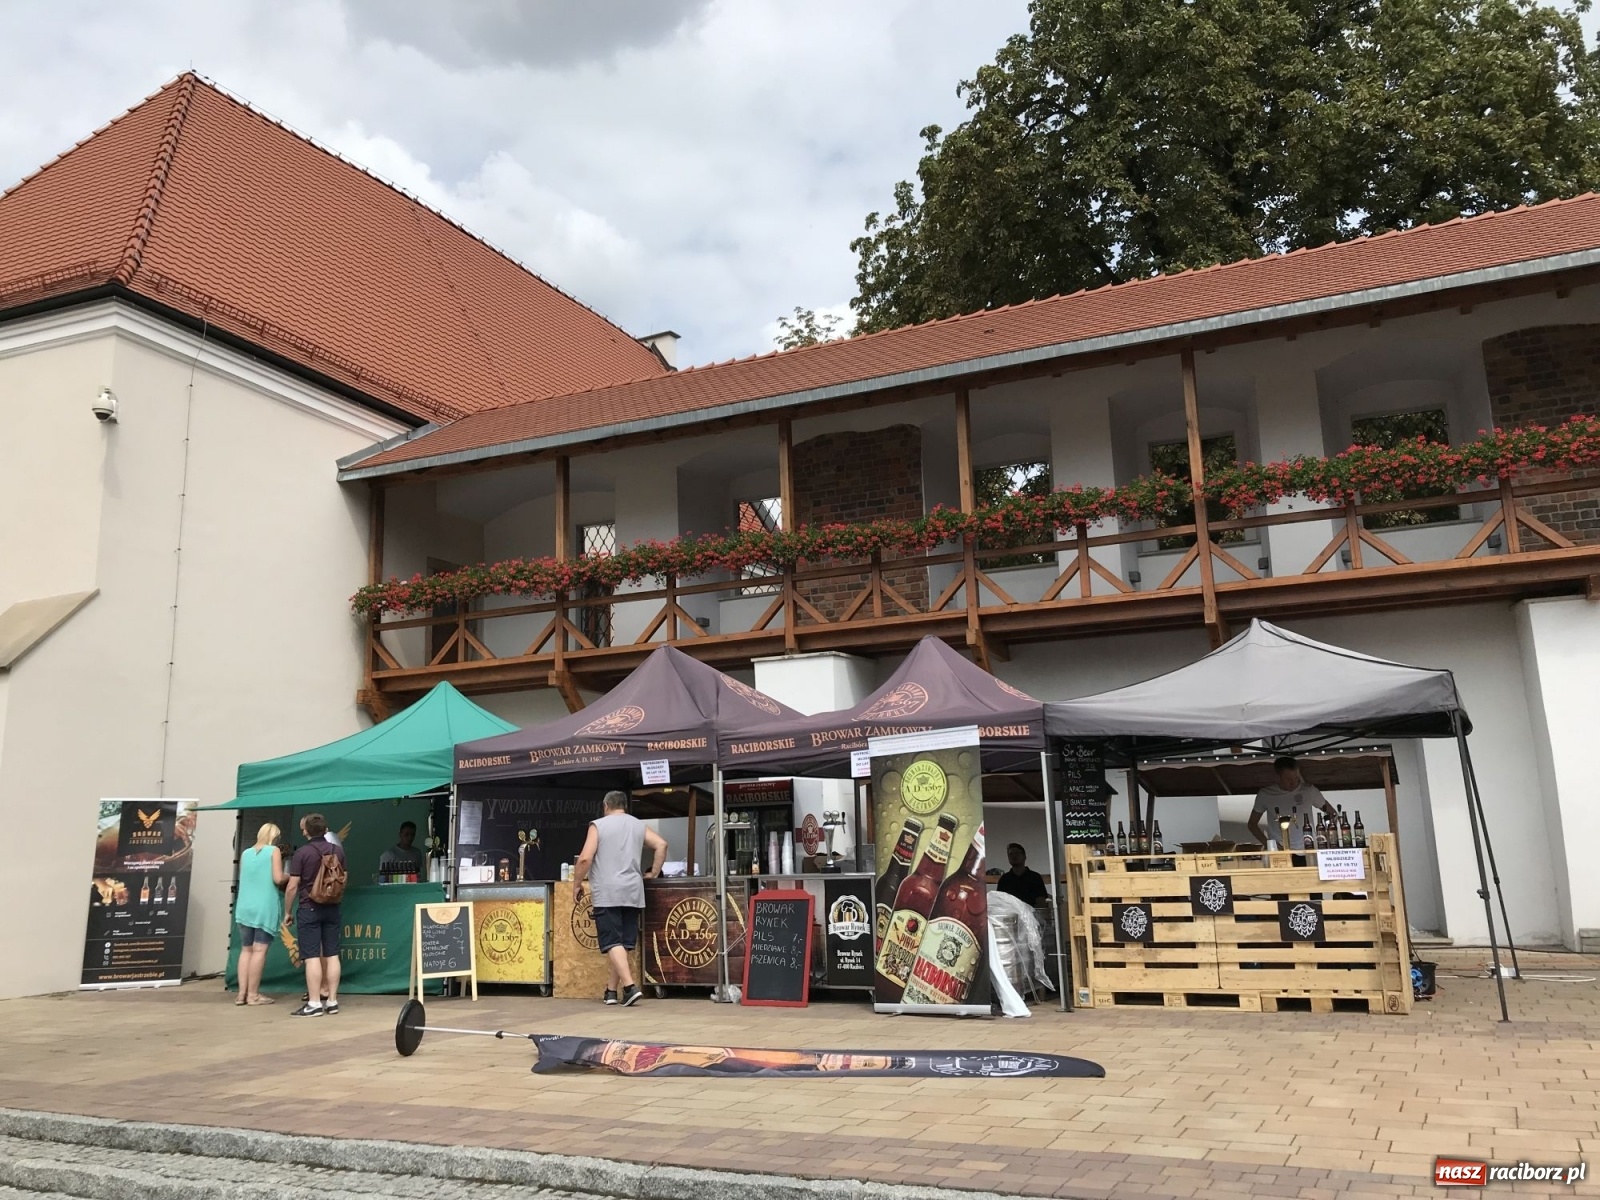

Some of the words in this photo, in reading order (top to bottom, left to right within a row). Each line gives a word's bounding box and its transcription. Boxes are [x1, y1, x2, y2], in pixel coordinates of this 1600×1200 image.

[810, 726, 862, 747] BROWAR
[978, 724, 1030, 738] BORSKIE
[647, 738, 708, 752] RACIBORSKIE
[731, 738, 796, 754] RACIBORSKIE
[529, 745, 572, 764] BROWAR
[573, 742, 627, 756] ZAMKOWY
[459, 755, 511, 769] RACIBORSKIE
[925, 784, 942, 794] 1567
[726, 790, 790, 803] RACIBORSKIE
[669, 901, 690, 926] BROWAR
[756, 902, 795, 914] BROWAR
[755, 916, 788, 929] RYNEK
[851, 923, 866, 931] Rynek
[344, 924, 381, 938] OWAR
[452, 922, 463, 939] 5
[695, 929, 718, 944] 1567
[753, 931, 774, 941] PILS
[502, 932, 519, 945] 1567
[578, 933, 597, 947] RACIB
[457, 940, 464, 954] 7
[752, 944, 786, 953] MIEDZIANE
[340, 948, 386, 962] TRZĘBIE
[751, 955, 786, 967] PSZENICA
[448, 958, 456, 968] 6
[99, 972, 164, 980] www.browarjastrzebie.pl
